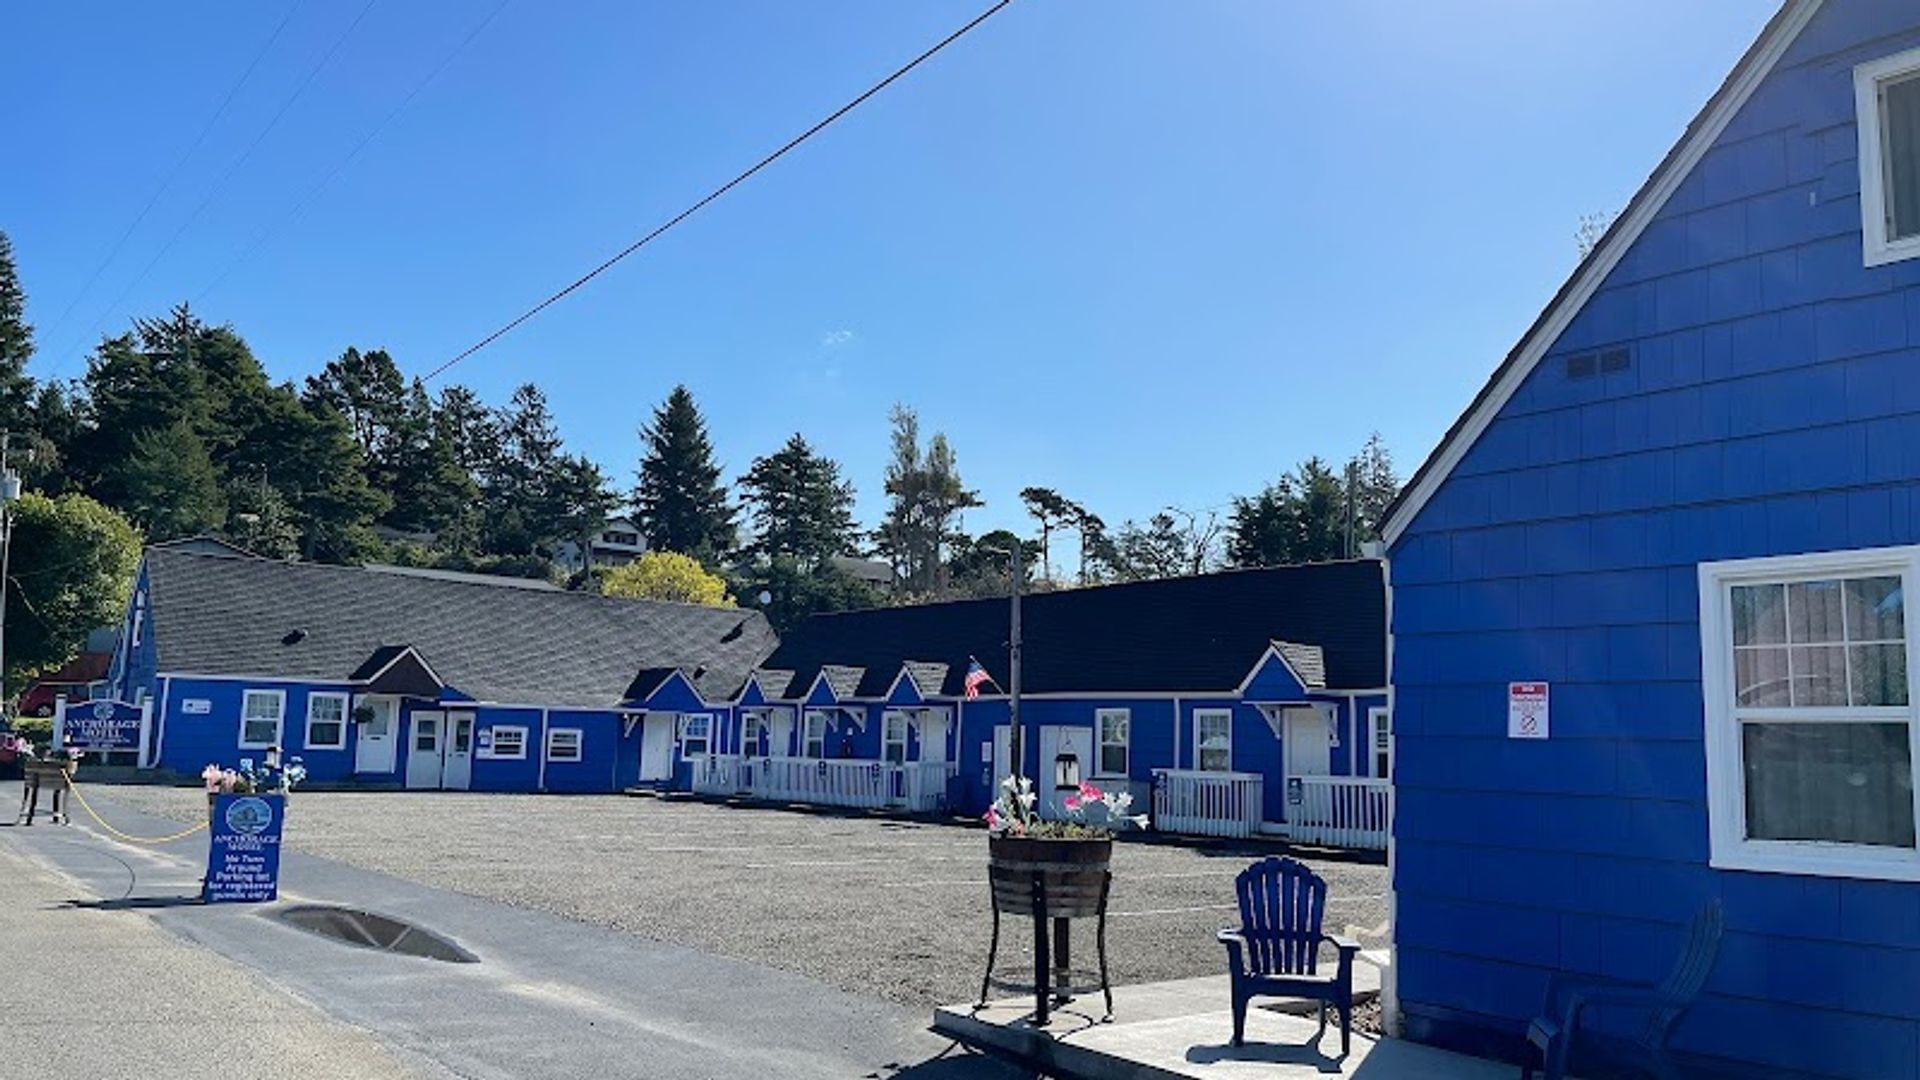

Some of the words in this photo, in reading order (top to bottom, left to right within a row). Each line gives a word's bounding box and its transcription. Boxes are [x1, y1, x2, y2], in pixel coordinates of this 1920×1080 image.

[225, 854, 240, 863] No
[242, 854, 265, 863] Turn
[225, 864, 263, 873] Around
[216, 872, 254, 883] Parking
[225, 881, 275, 892] registered
